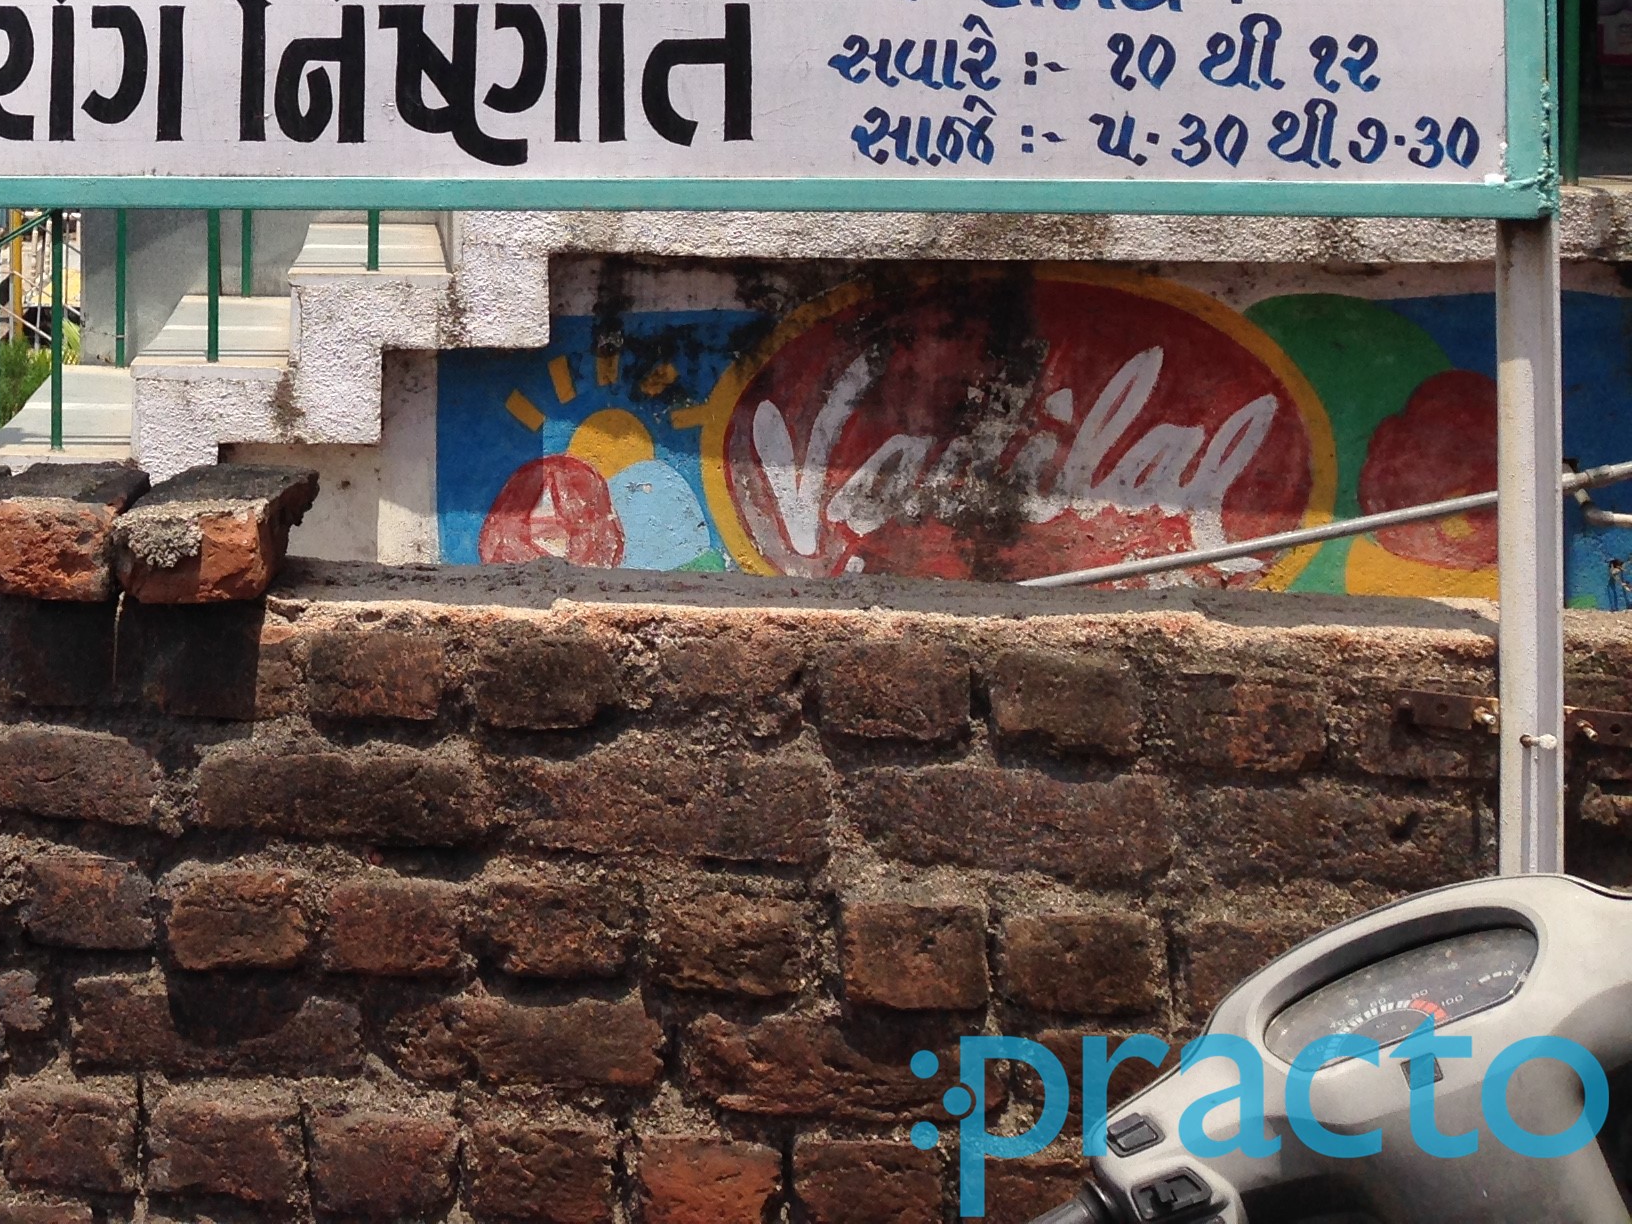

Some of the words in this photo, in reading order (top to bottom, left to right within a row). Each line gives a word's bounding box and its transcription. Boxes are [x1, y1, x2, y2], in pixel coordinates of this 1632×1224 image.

[828, 14, 1001, 91] સવારે
[1107, 33, 1176, 90] ૧૦
[1199, 13, 1285, 91] થી
[1309, 35, 1381, 92] ૧૨
[1267, 98, 1340, 169] થી
[1440, 994, 1464, 1007] 100
